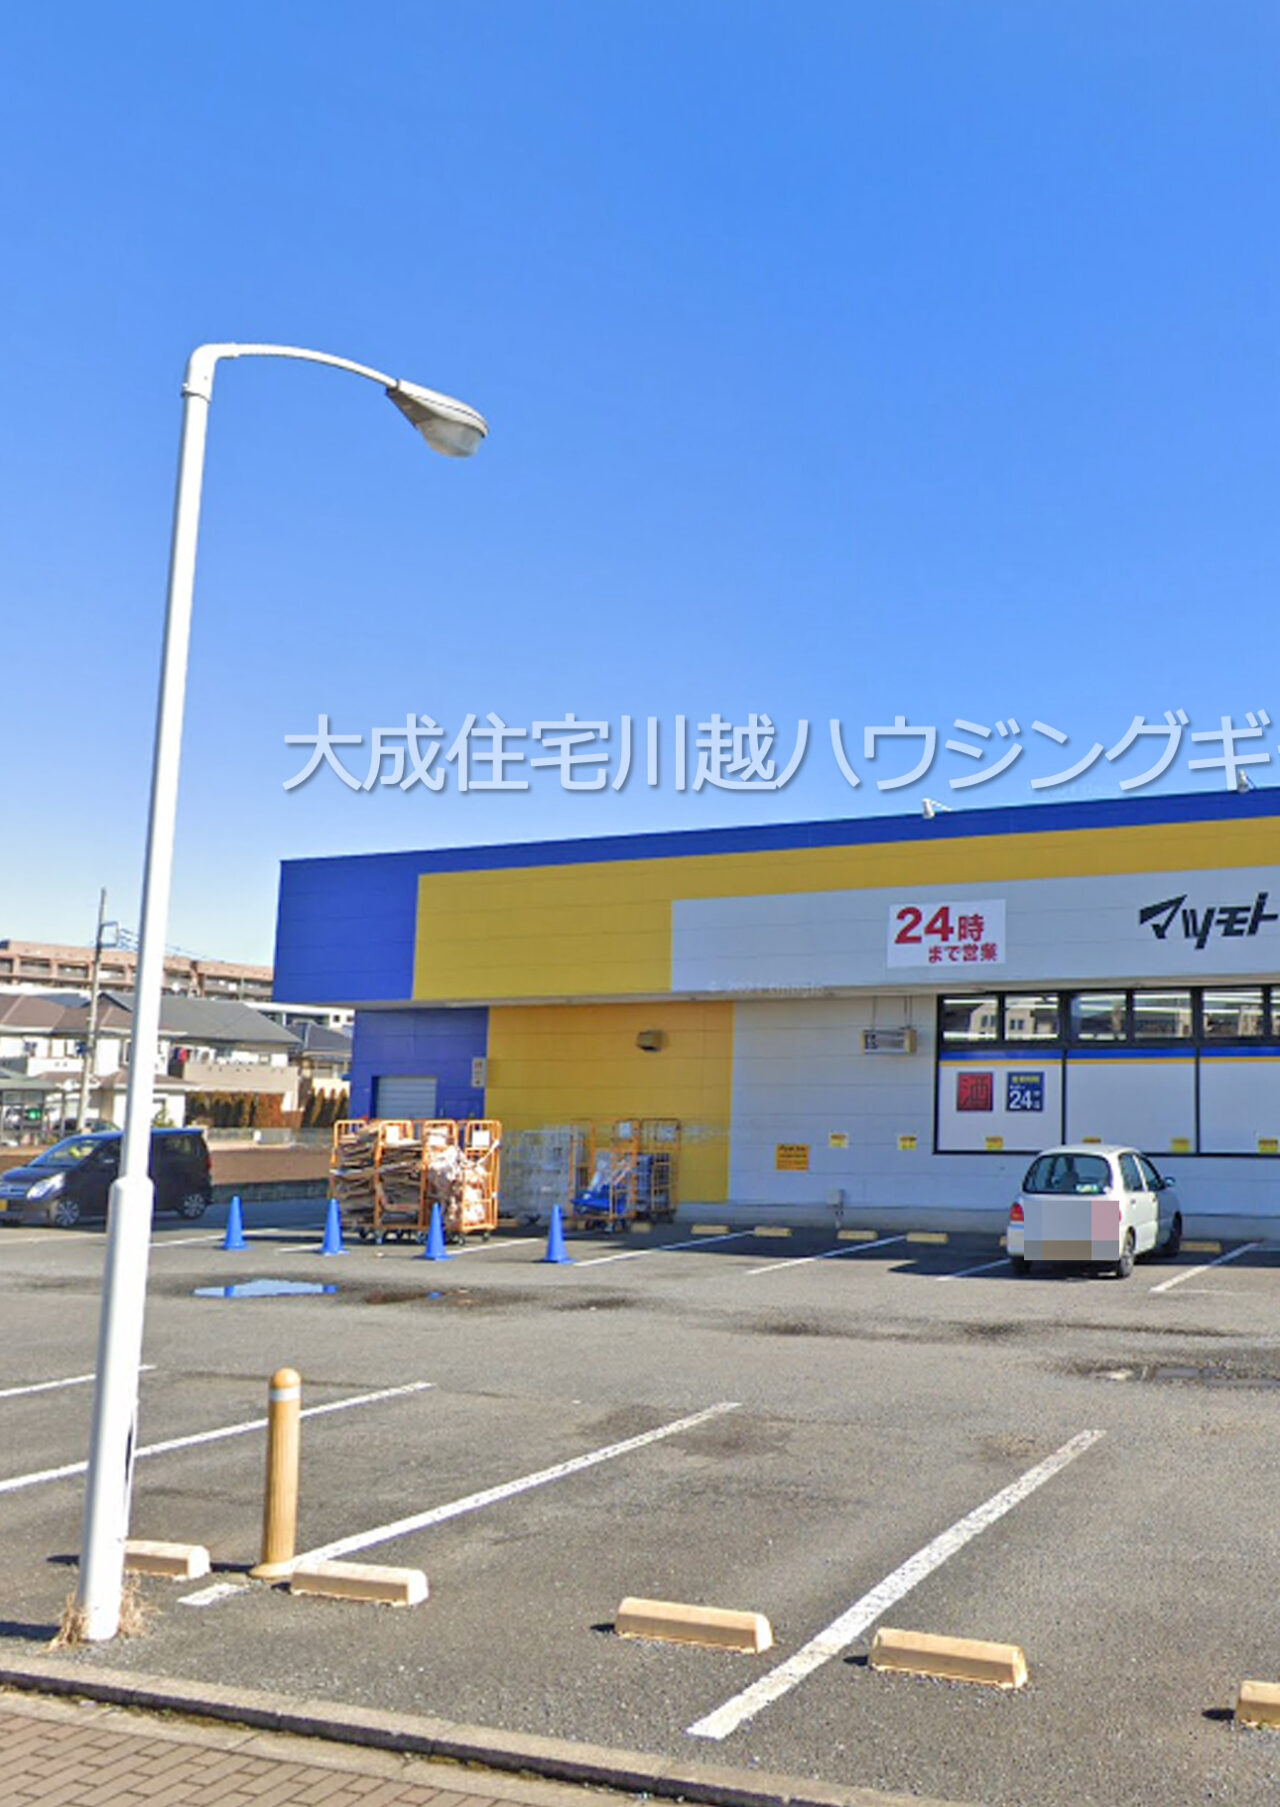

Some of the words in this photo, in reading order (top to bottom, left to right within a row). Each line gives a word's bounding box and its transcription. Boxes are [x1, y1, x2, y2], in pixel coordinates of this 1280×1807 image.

[894, 905, 985, 944] 24時
[928, 942, 998, 963] まで営業
[1009, 1090, 1032, 1109] 24
